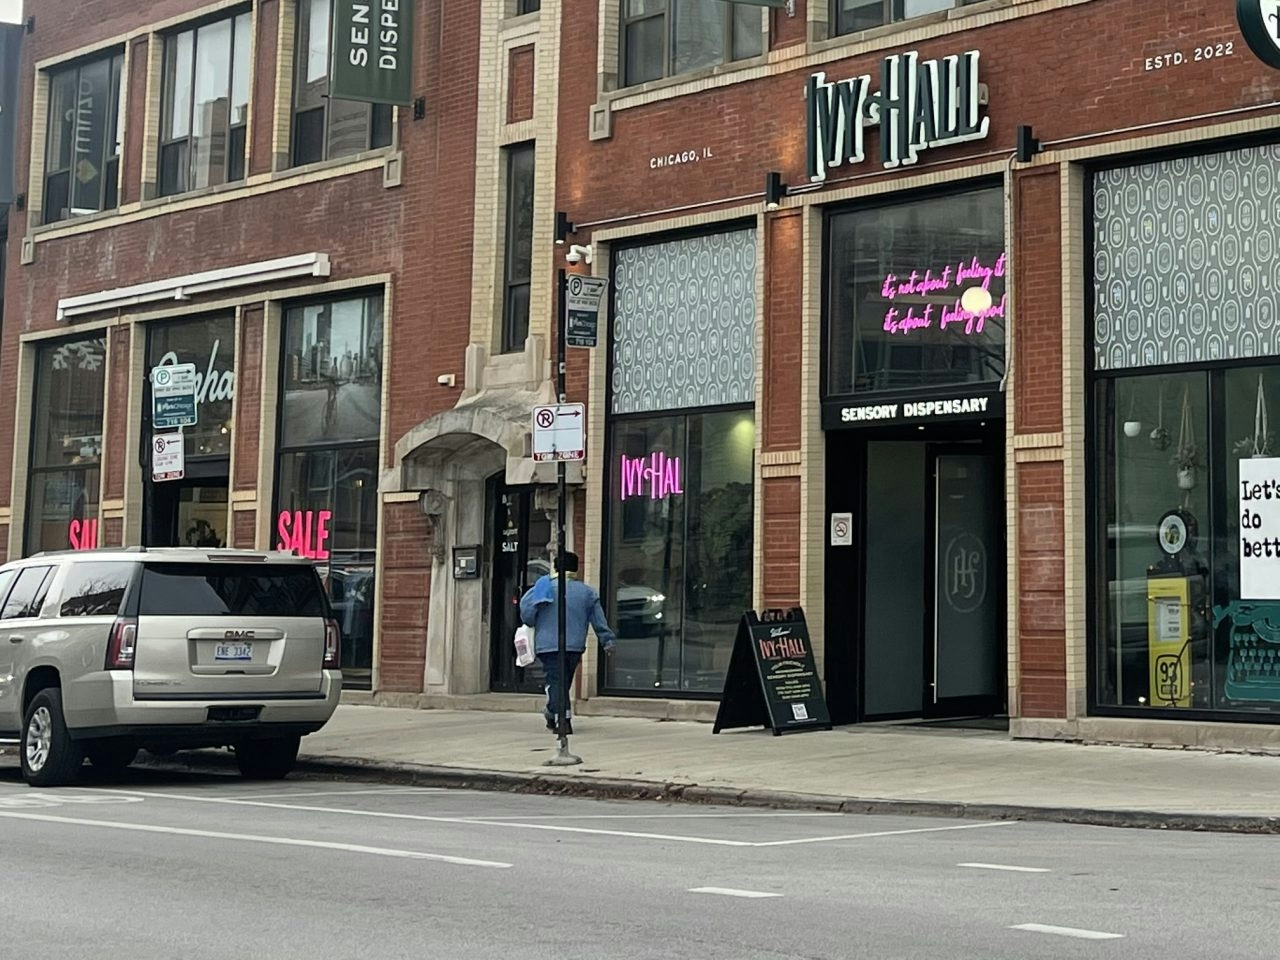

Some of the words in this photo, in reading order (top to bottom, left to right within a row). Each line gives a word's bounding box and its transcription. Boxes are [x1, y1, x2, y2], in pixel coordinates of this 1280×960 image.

[1145, 52, 1188, 71] ESTD.
[1194, 42, 1234, 62] 2022
[805, 71, 871, 182] IVY
[862, 50, 990, 168] HALL
[650, 150, 699, 169] CHICAGO,
[703, 147, 713, 158] IL
[898, 270, 918, 294] not
[916, 266, 952, 296] about
[956, 256, 993, 292] feeling
[899, 304, 933, 334] about
[841, 404, 898, 422] SENSORY
[903, 397, 988, 417] DISPENSARY
[621, 454, 645, 501] IVY
[1241, 508, 1262, 529] do
[277, 510, 332, 559] SALE
[225, 630, 255, 640] GMC
[759, 638, 777, 659] IVY
[776, 636, 807, 658] HALL
